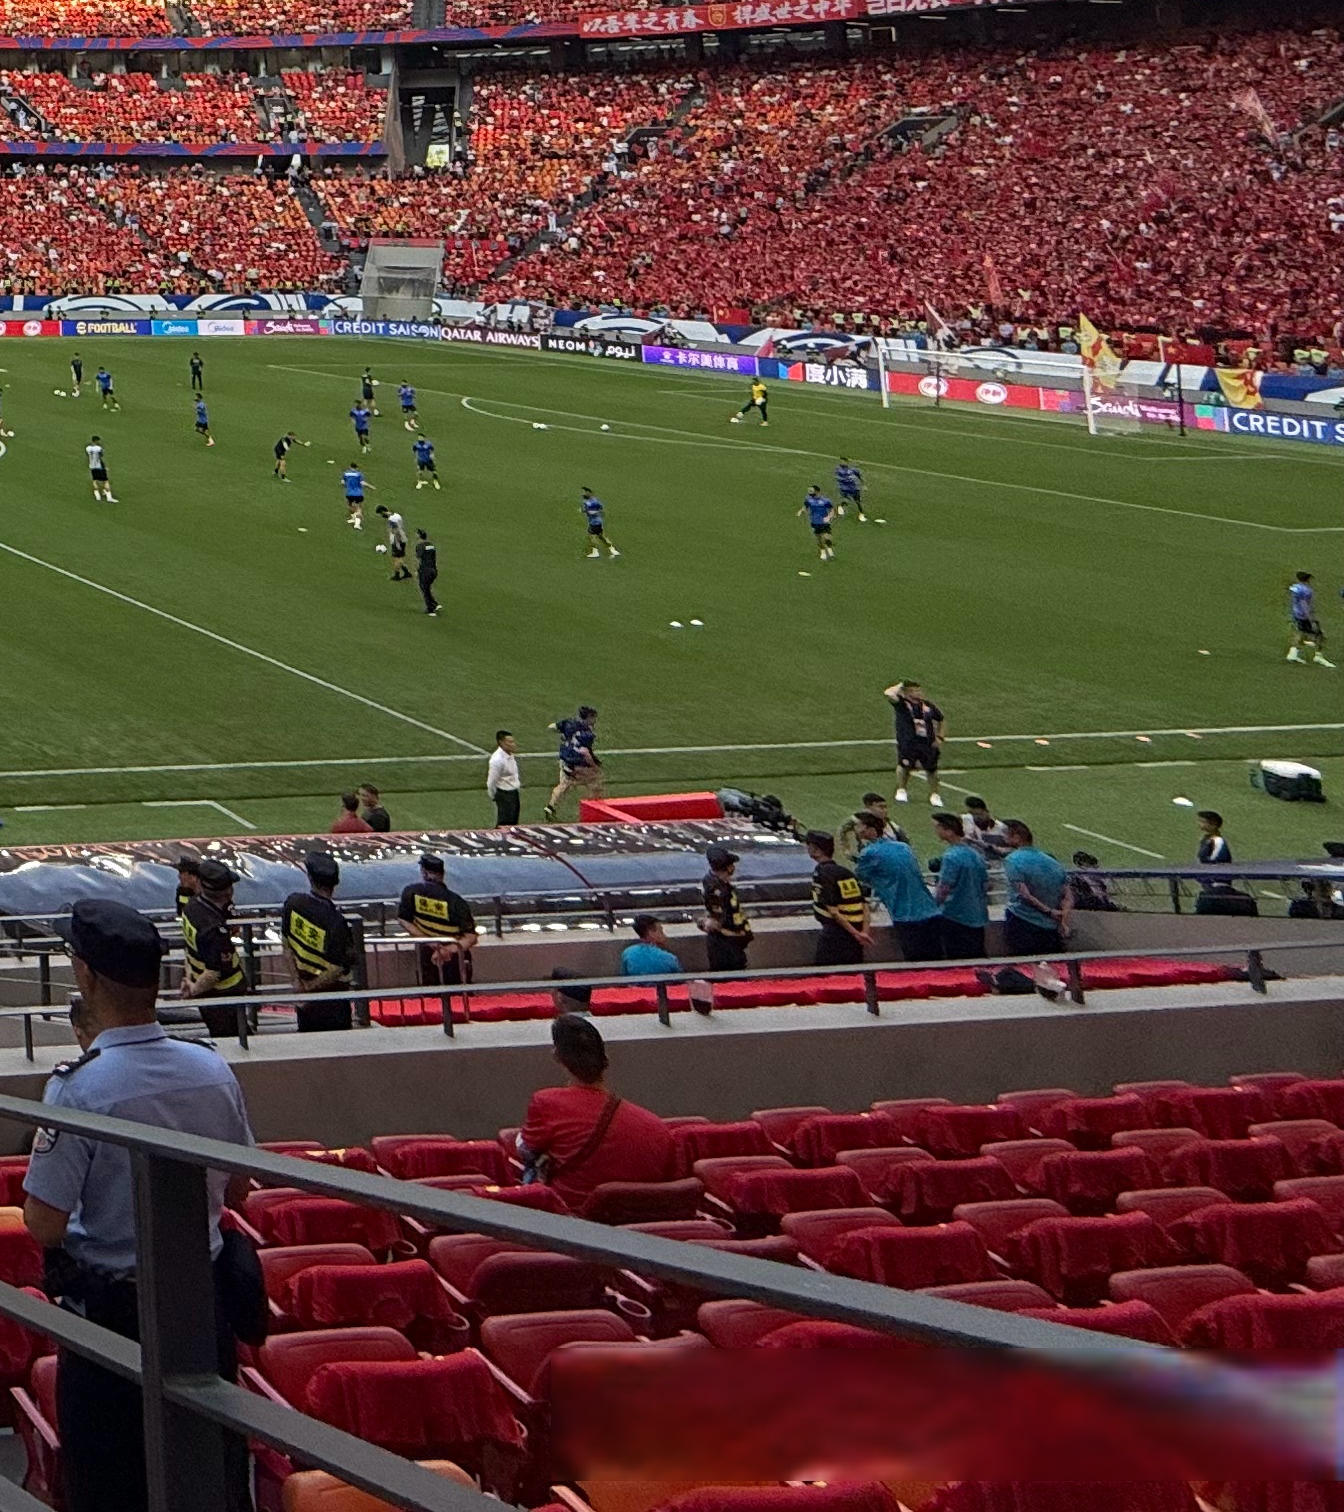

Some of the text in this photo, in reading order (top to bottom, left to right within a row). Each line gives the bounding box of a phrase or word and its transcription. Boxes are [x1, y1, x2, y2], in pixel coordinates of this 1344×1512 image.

[335, 321, 438, 338] CREDIT SAISON
[441, 327, 540, 347] QATAR AIRWAYS
[548, 339, 586, 352] NEOM
[677, 351, 739, 371] 卡尔美体育
[805, 363, 868, 389] 度小满
[1232, 412, 1328, 439] CREDIT
